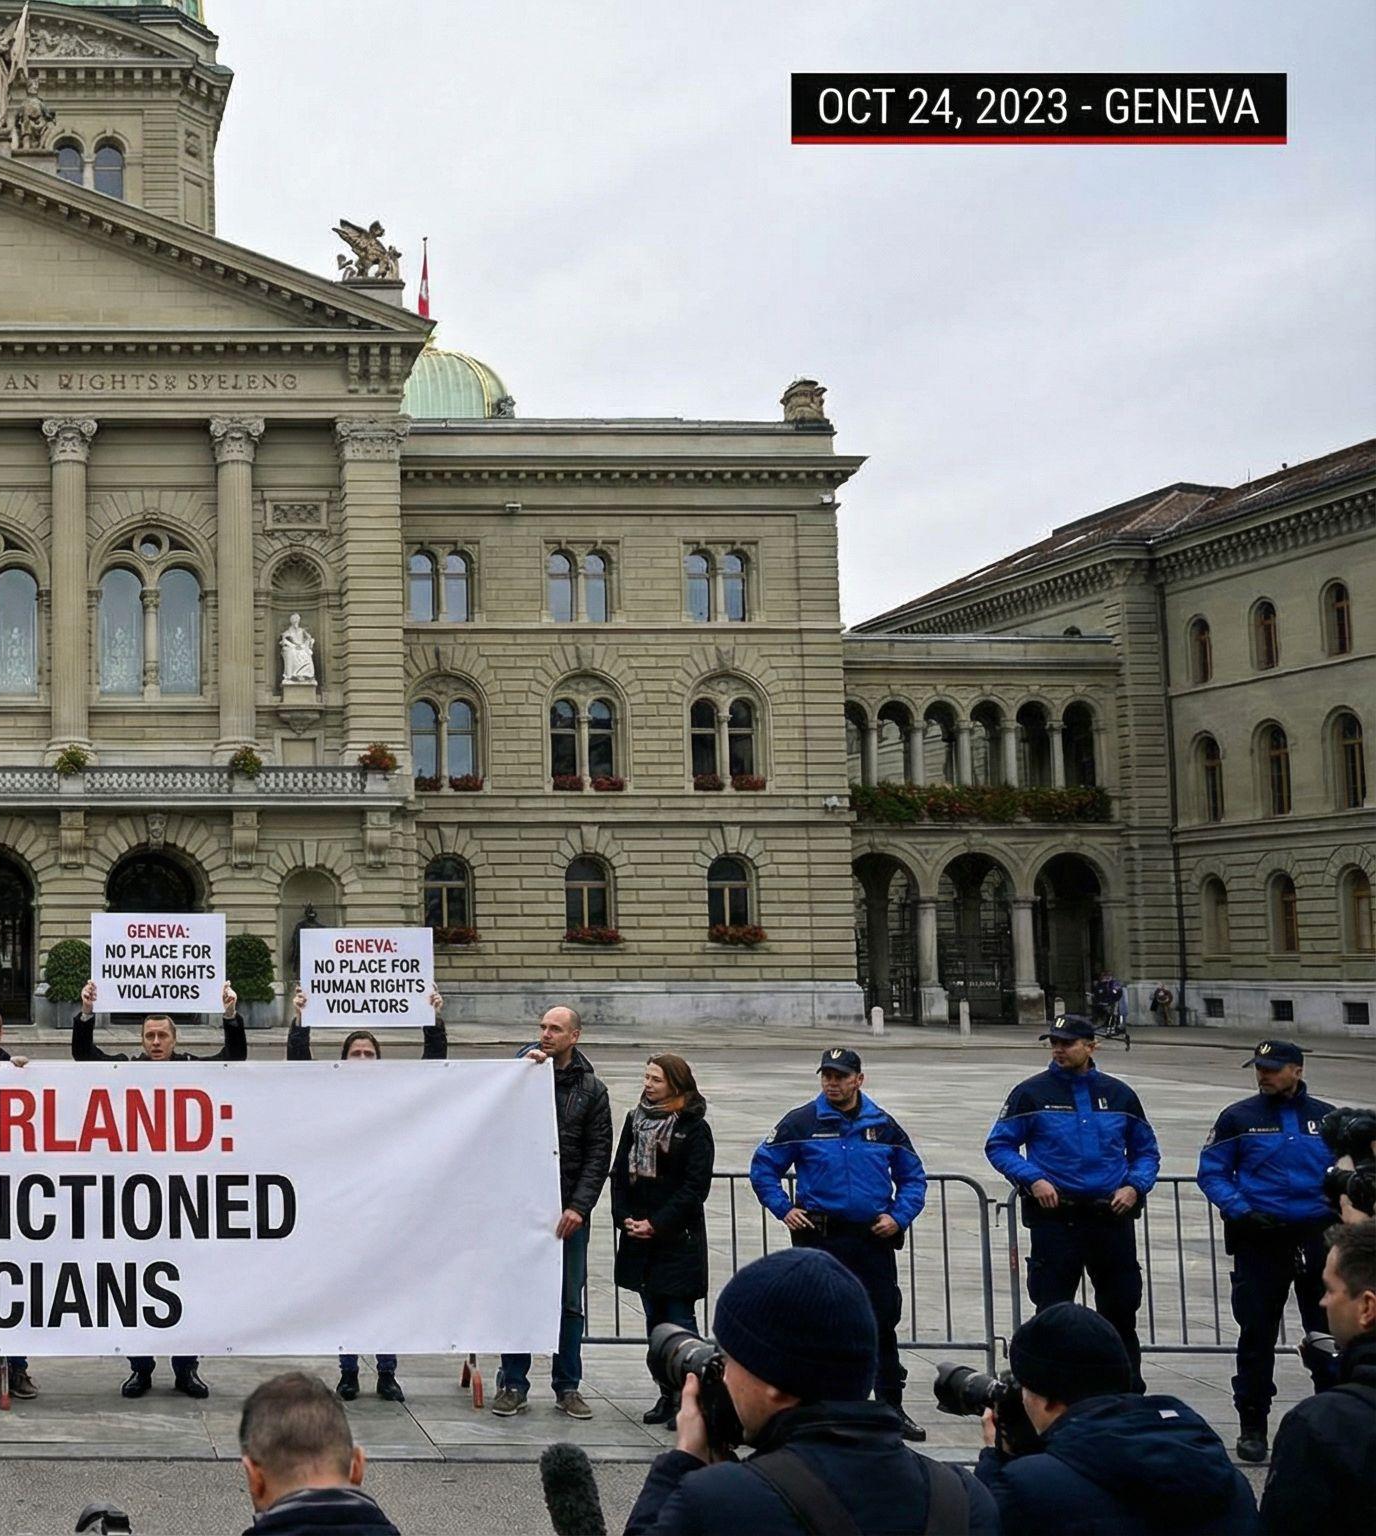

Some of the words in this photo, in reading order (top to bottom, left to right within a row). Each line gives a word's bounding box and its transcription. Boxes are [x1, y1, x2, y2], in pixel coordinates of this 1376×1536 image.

[127, 924, 190, 939] GENEVA:
[105, 944, 126, 959] NO
[131, 944, 178, 959] PLACE
[182, 944, 211, 960] FOR
[335, 938, 398, 954] GENEVA:
[102, 964, 156, 979] HUMAN
[162, 964, 216, 980] RIGHTS
[314, 958, 335, 974] NO
[339, 958, 387, 974] PLACE
[391, 958, 420, 974] FOR
[117, 984, 200, 1000] VIOLATORS
[311, 978, 366, 994] HUMAN
[371, 978, 425, 994] RIGHTS
[326, 998, 409, 1014] VIOLATORS
